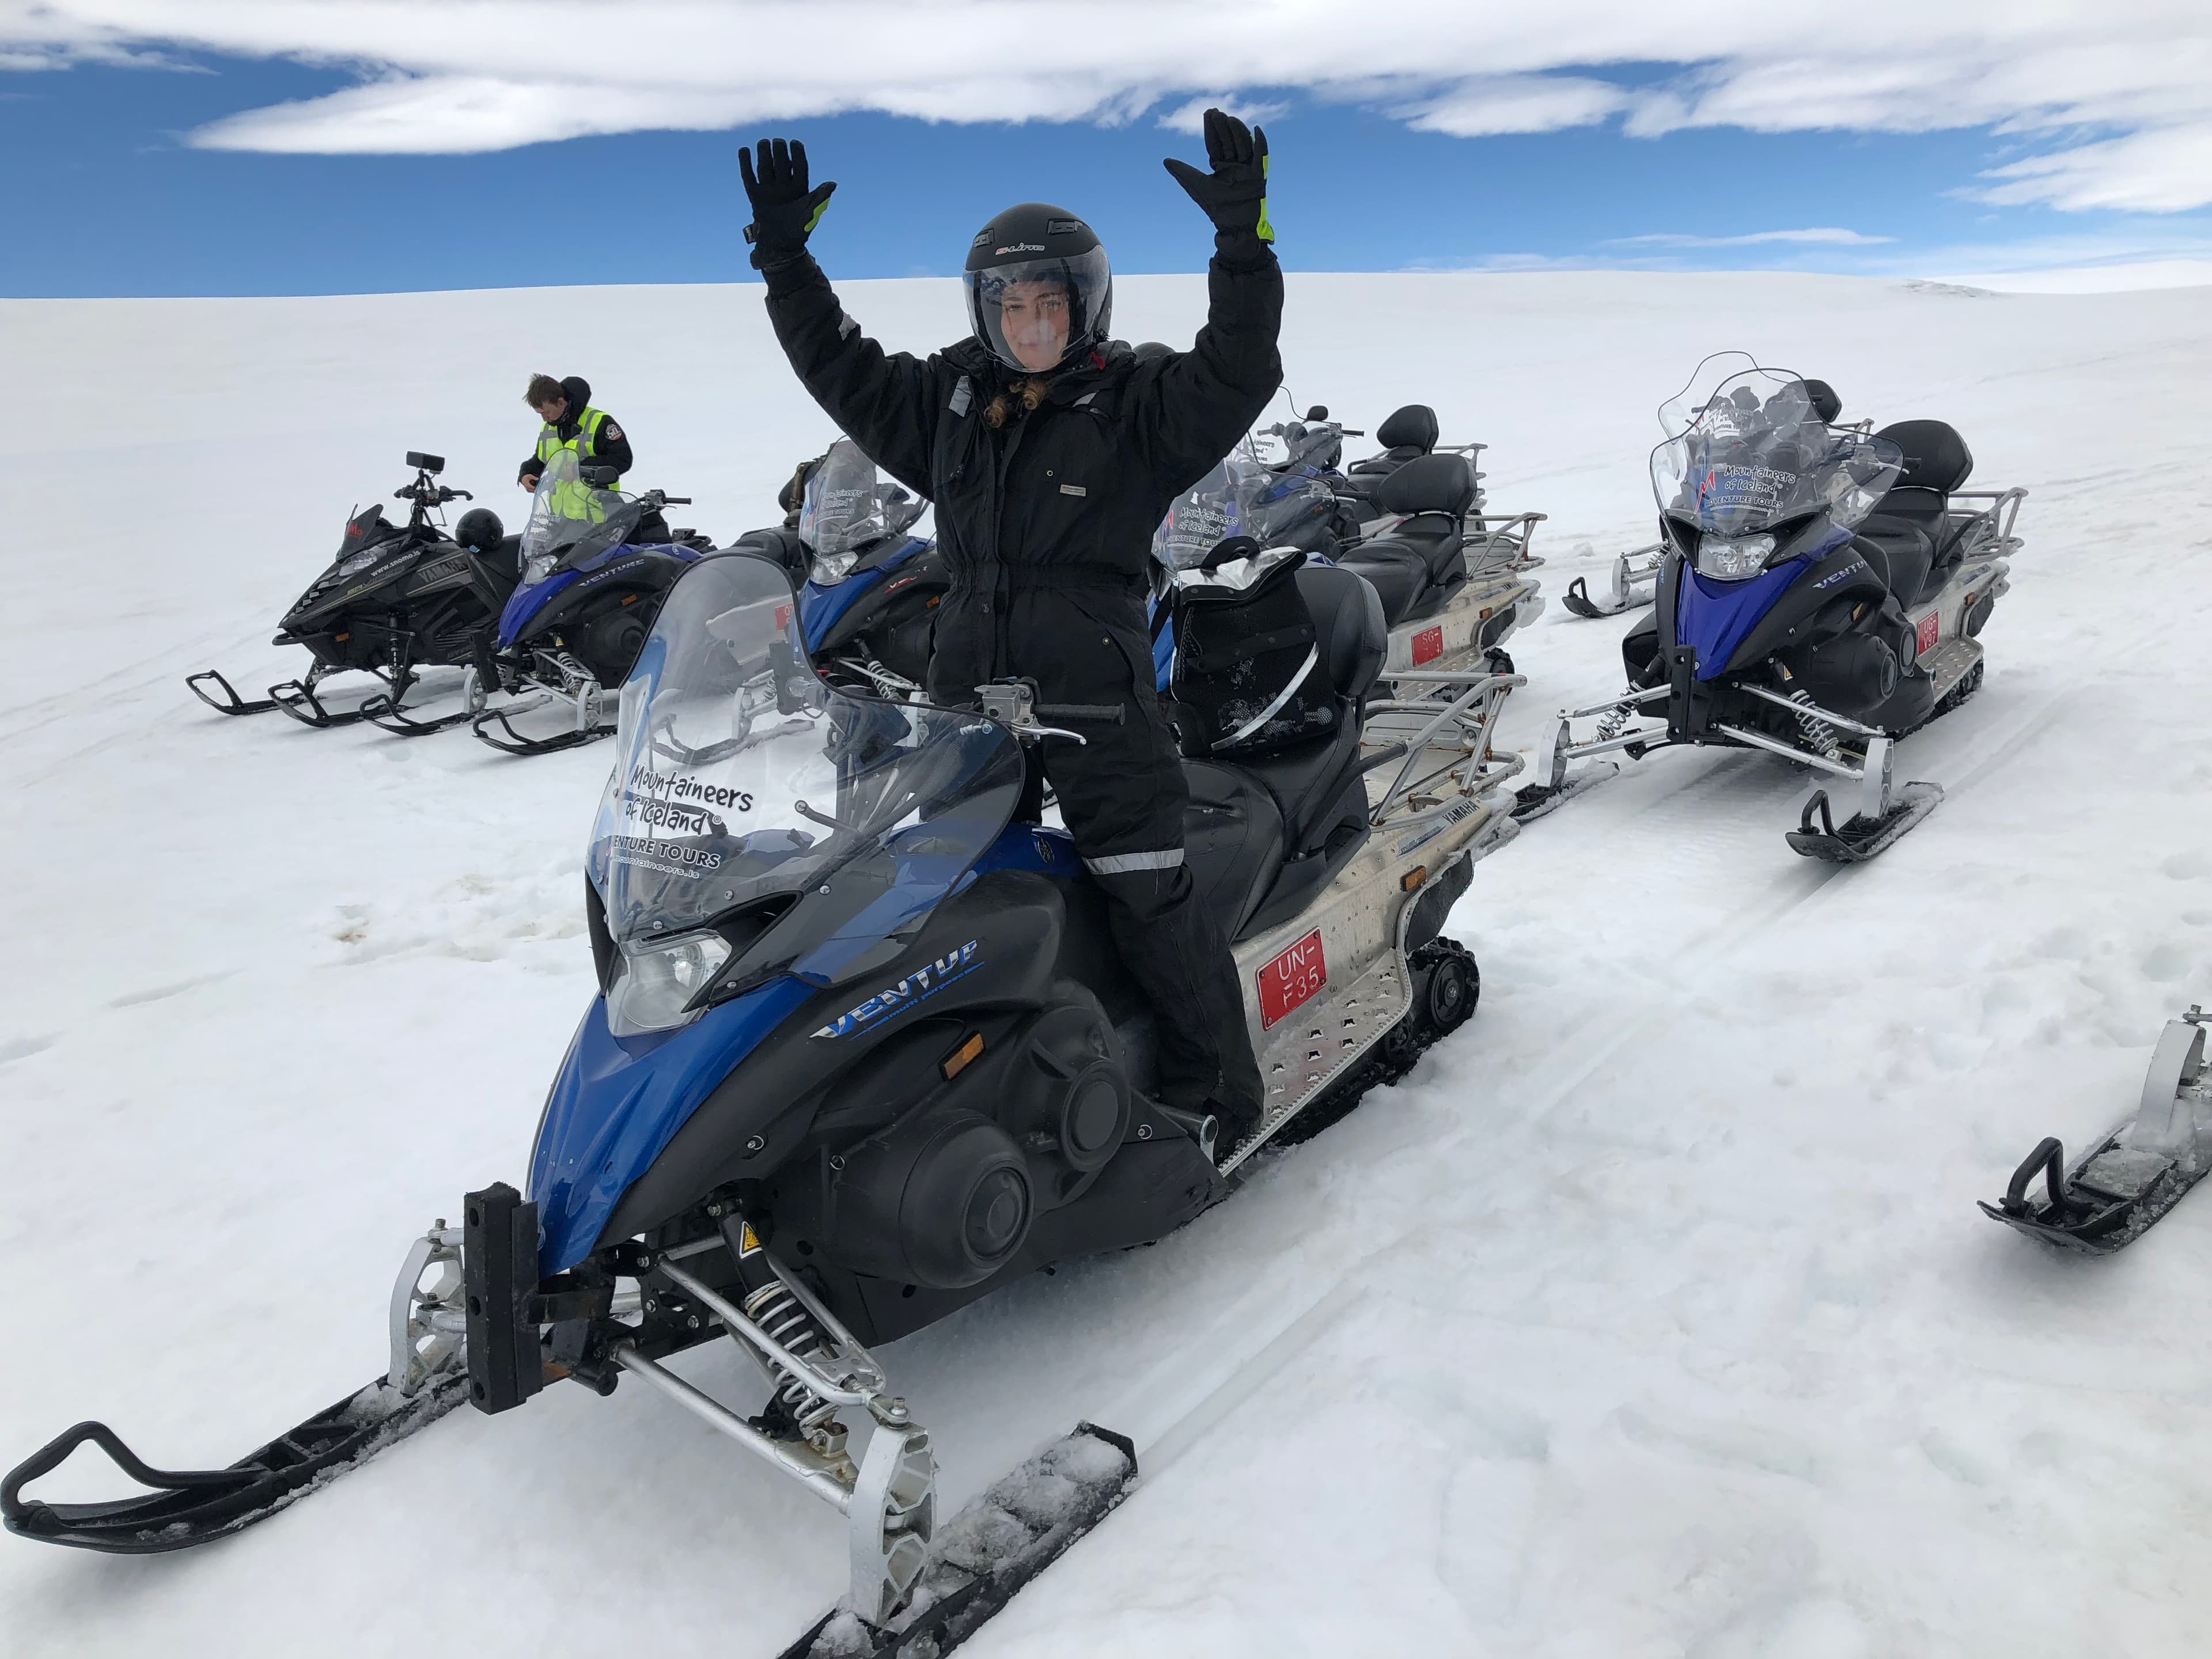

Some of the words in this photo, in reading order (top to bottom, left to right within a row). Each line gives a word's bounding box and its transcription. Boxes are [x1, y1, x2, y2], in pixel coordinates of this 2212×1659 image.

[1724, 465, 1796, 484] Mountaineers
[1725, 479, 1737, 490] of
[1737, 479, 1776, 494] Iceland
[1753, 497, 1783, 508] TOURS
[1178, 520, 1189, 531] of
[1188, 520, 1221, 536] Iceland
[1180, 507, 1238, 526] Mountaineers
[370, 550, 421, 577] www.snomo.is
[578, 559, 645, 586] VENTURE
[1812, 559, 1868, 589] VENTU
[1923, 618, 1937, 634] UG-
[1923, 631, 1937, 650] V97
[630, 764, 753, 812] Mountaineers
[626, 797, 641, 821] of
[639, 798, 708, 835] Iceland
[1442, 800, 1480, 825] YAMAHA
[658, 842, 721, 869] TOURS
[1277, 944, 1316, 981] UN-
[1282, 965, 1320, 1009] F35
